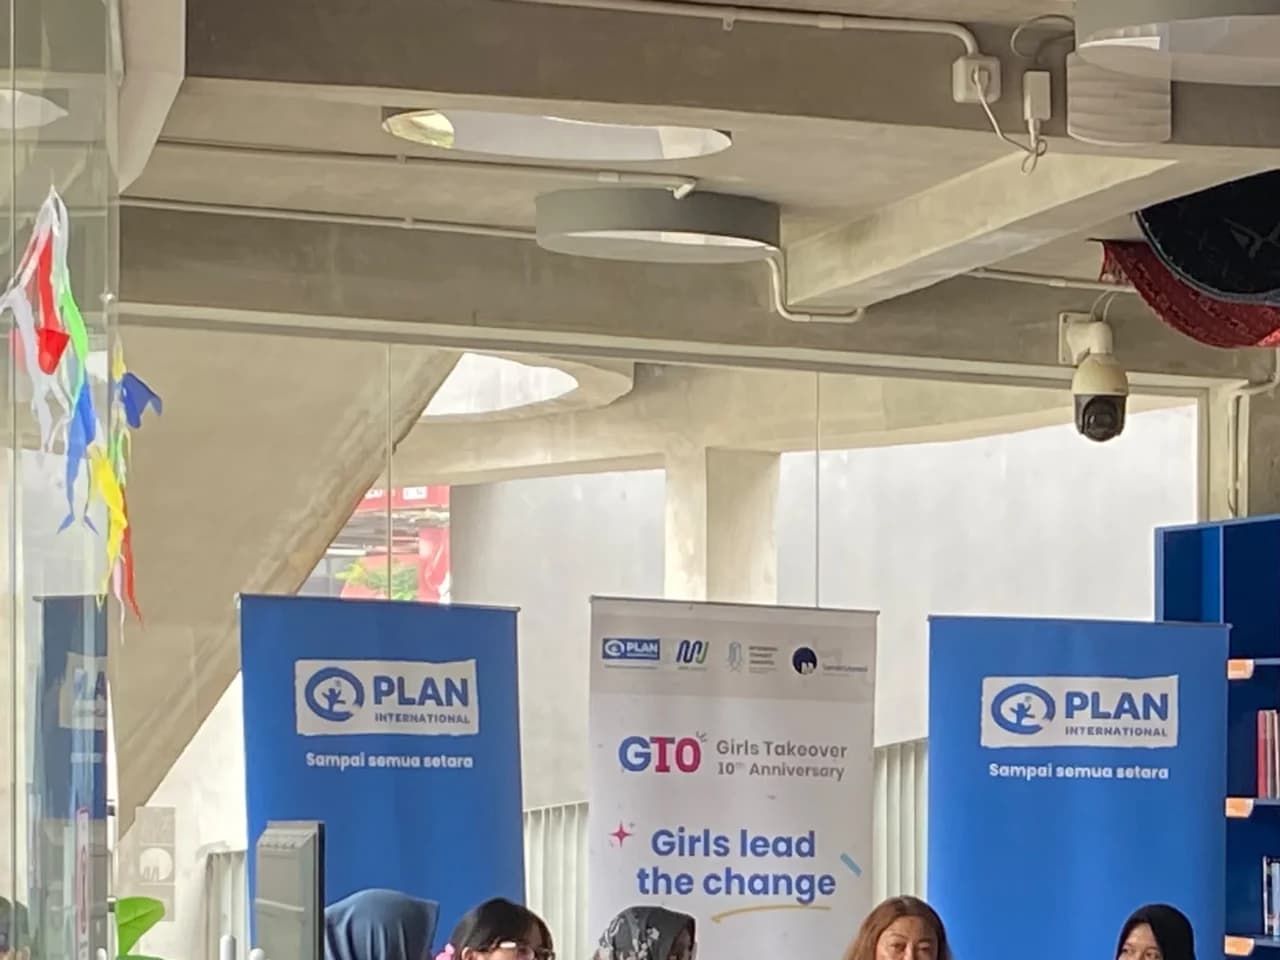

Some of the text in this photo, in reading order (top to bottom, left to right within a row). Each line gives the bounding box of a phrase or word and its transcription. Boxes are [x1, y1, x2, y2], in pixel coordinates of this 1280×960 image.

[627, 642, 658, 653] PLAN
[372, 675, 468, 707] PLAN
[1065, 691, 1169, 721] PLAN
[374, 712, 471, 724] INTERNATIONAL
[1065, 726, 1168, 737] INTERNATIONAL
[618, 735, 702, 773] GTO
[716, 740, 848, 758] Girls Takeover
[306, 752, 474, 771] Sampai semua setara
[989, 762, 1169, 780] Sampai semua setara
[749, 762, 846, 782] Anniversary
[651, 826, 816, 858] Girls lead
[637, 866, 836, 905] the change
